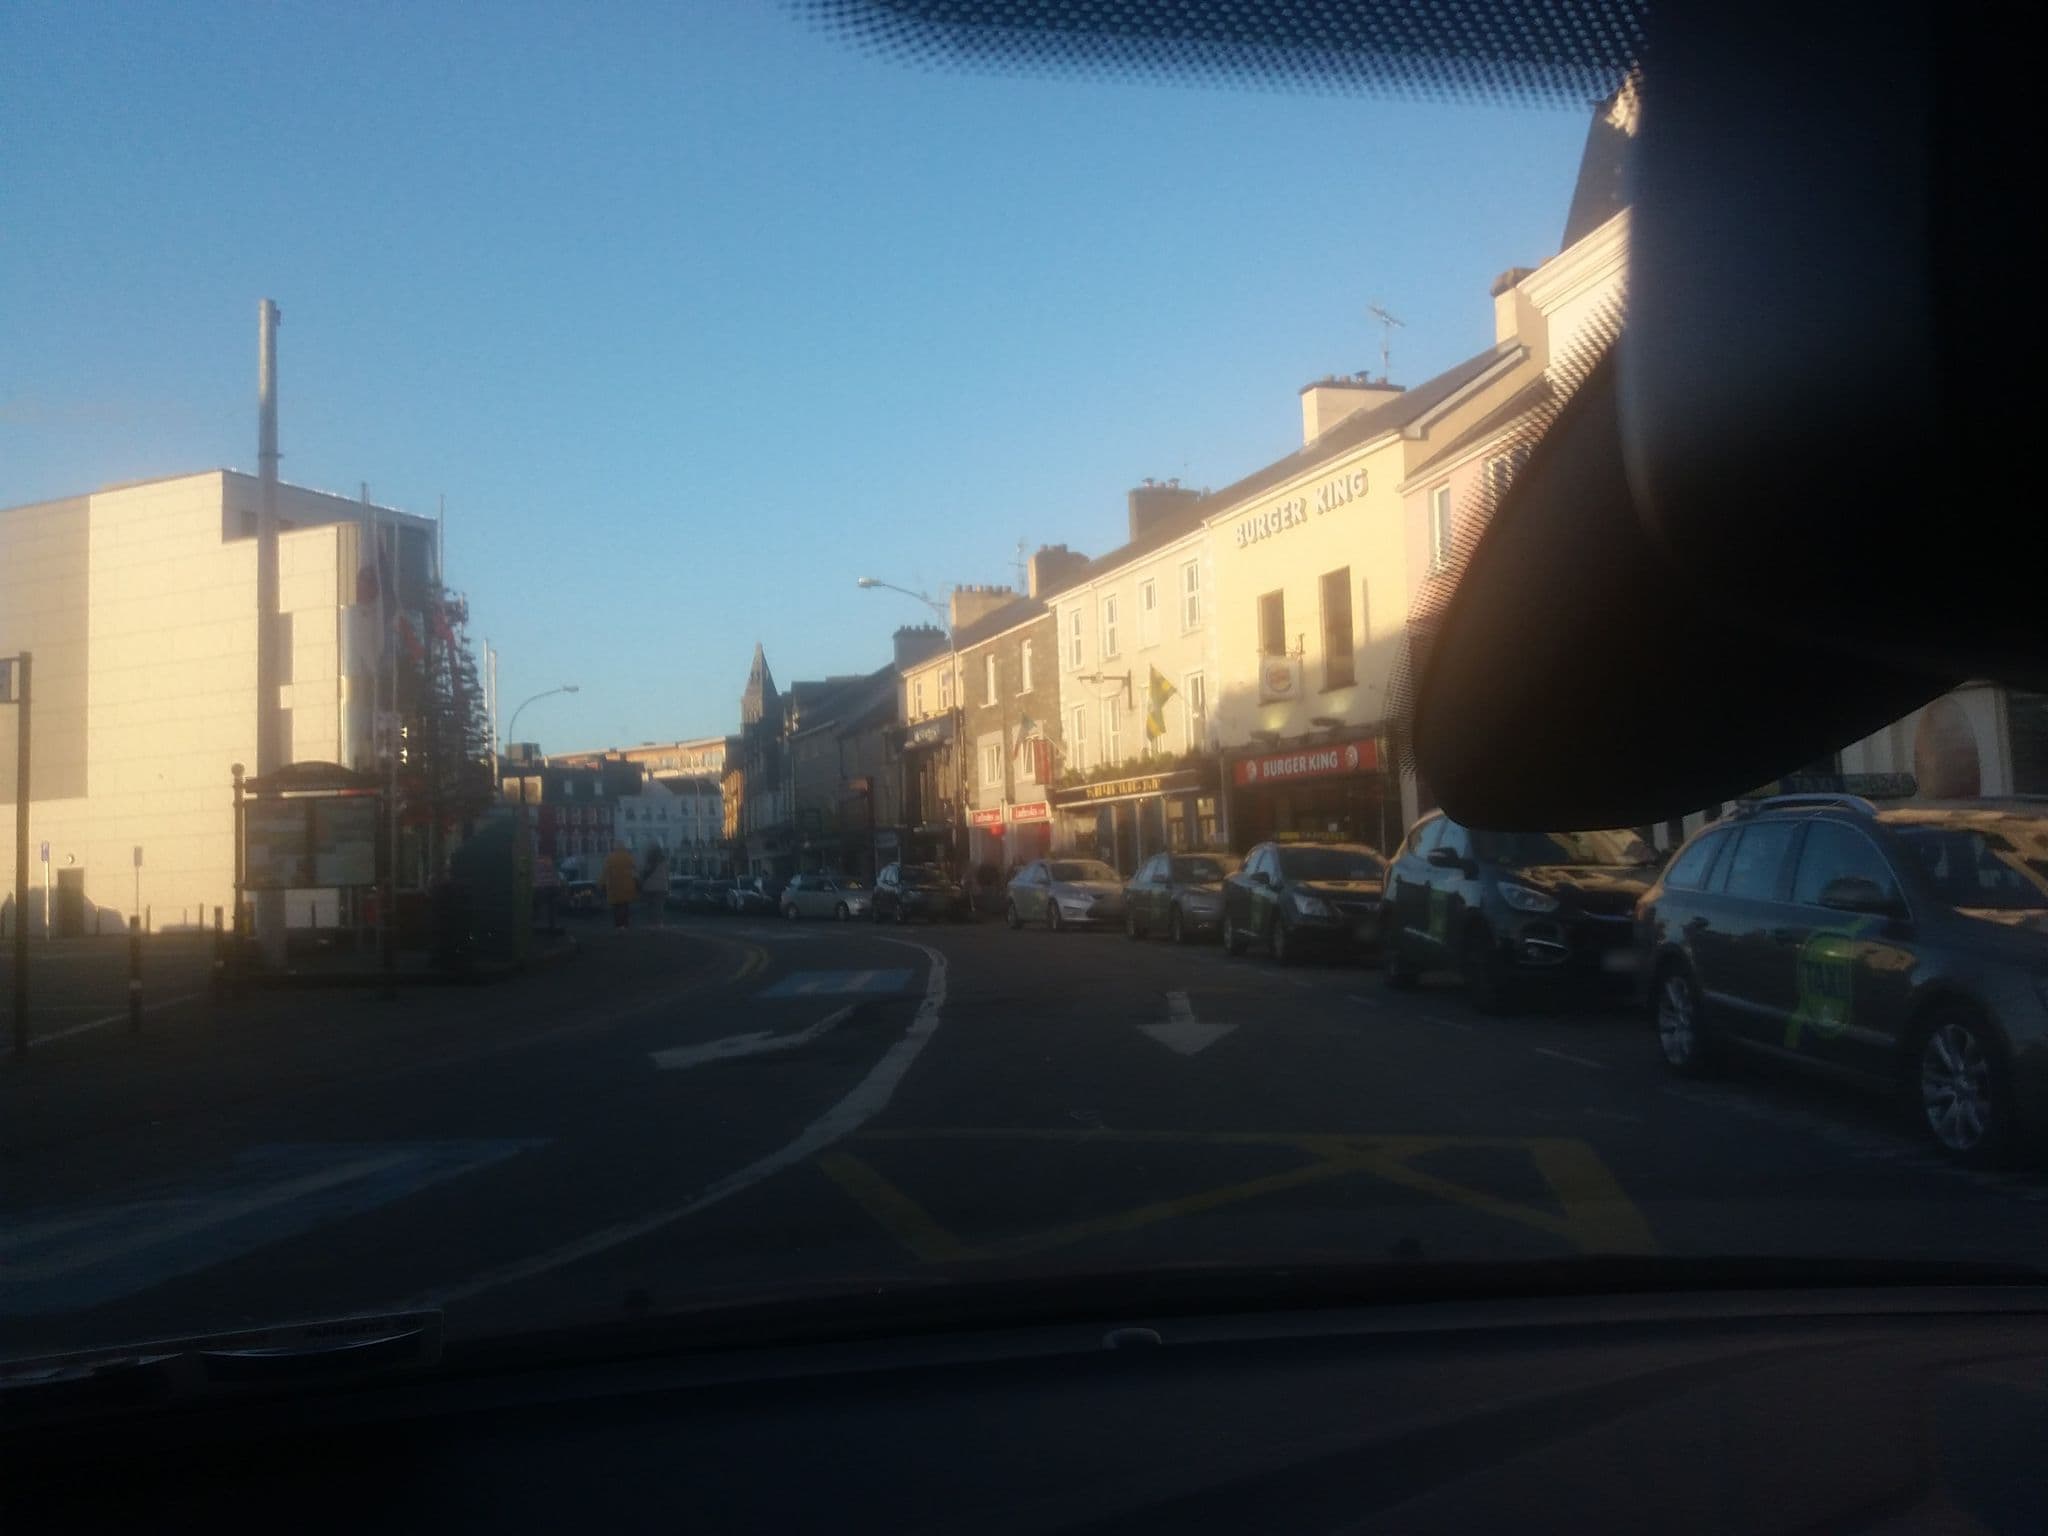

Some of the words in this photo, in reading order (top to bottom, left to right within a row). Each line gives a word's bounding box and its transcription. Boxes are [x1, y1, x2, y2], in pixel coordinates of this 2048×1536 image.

[1235, 497, 1307, 548] BURGER
[1313, 468, 1369, 515] KING
[1263, 756, 1306, 777] BURGER
[1309, 751, 1338, 771] KING
